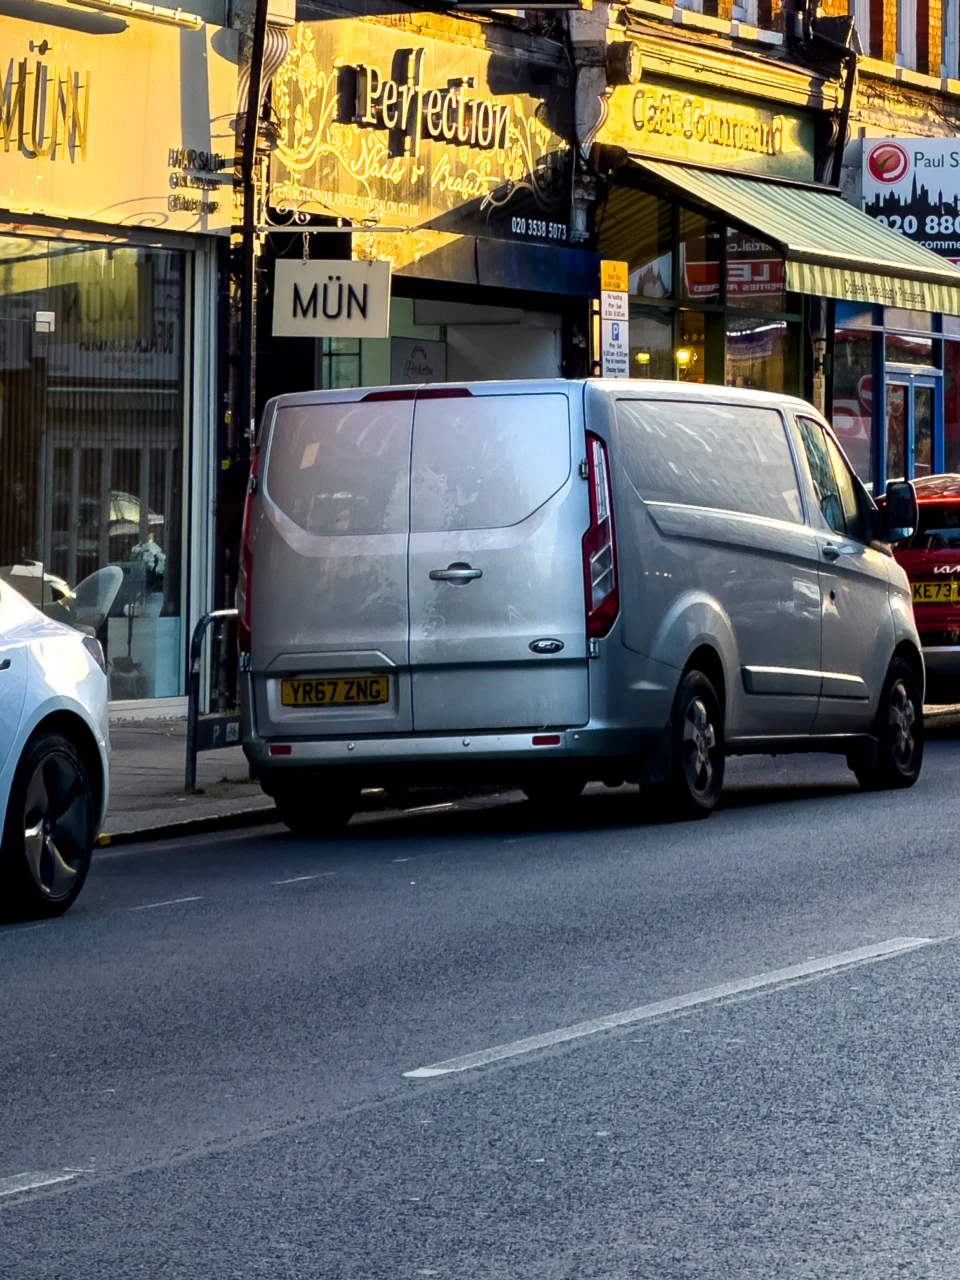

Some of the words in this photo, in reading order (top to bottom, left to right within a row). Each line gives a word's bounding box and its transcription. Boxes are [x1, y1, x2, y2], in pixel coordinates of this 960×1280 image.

[363, 47, 512, 158] Perfection
[914, 151, 945, 168] Paul
[351, 137, 406, 184] Nails
[431, 153, 501, 211] Beauty
[511, 216, 526, 233] 020
[528, 218, 547, 236] 3538
[548, 221, 567, 240] 5073
[293, 275, 368, 319] MÜN
[933, 564, 960, 574] KIA
[913, 583, 952, 599] KE73
[290, 681, 338, 702] YR67
[343, 680, 381, 700] ZNG
